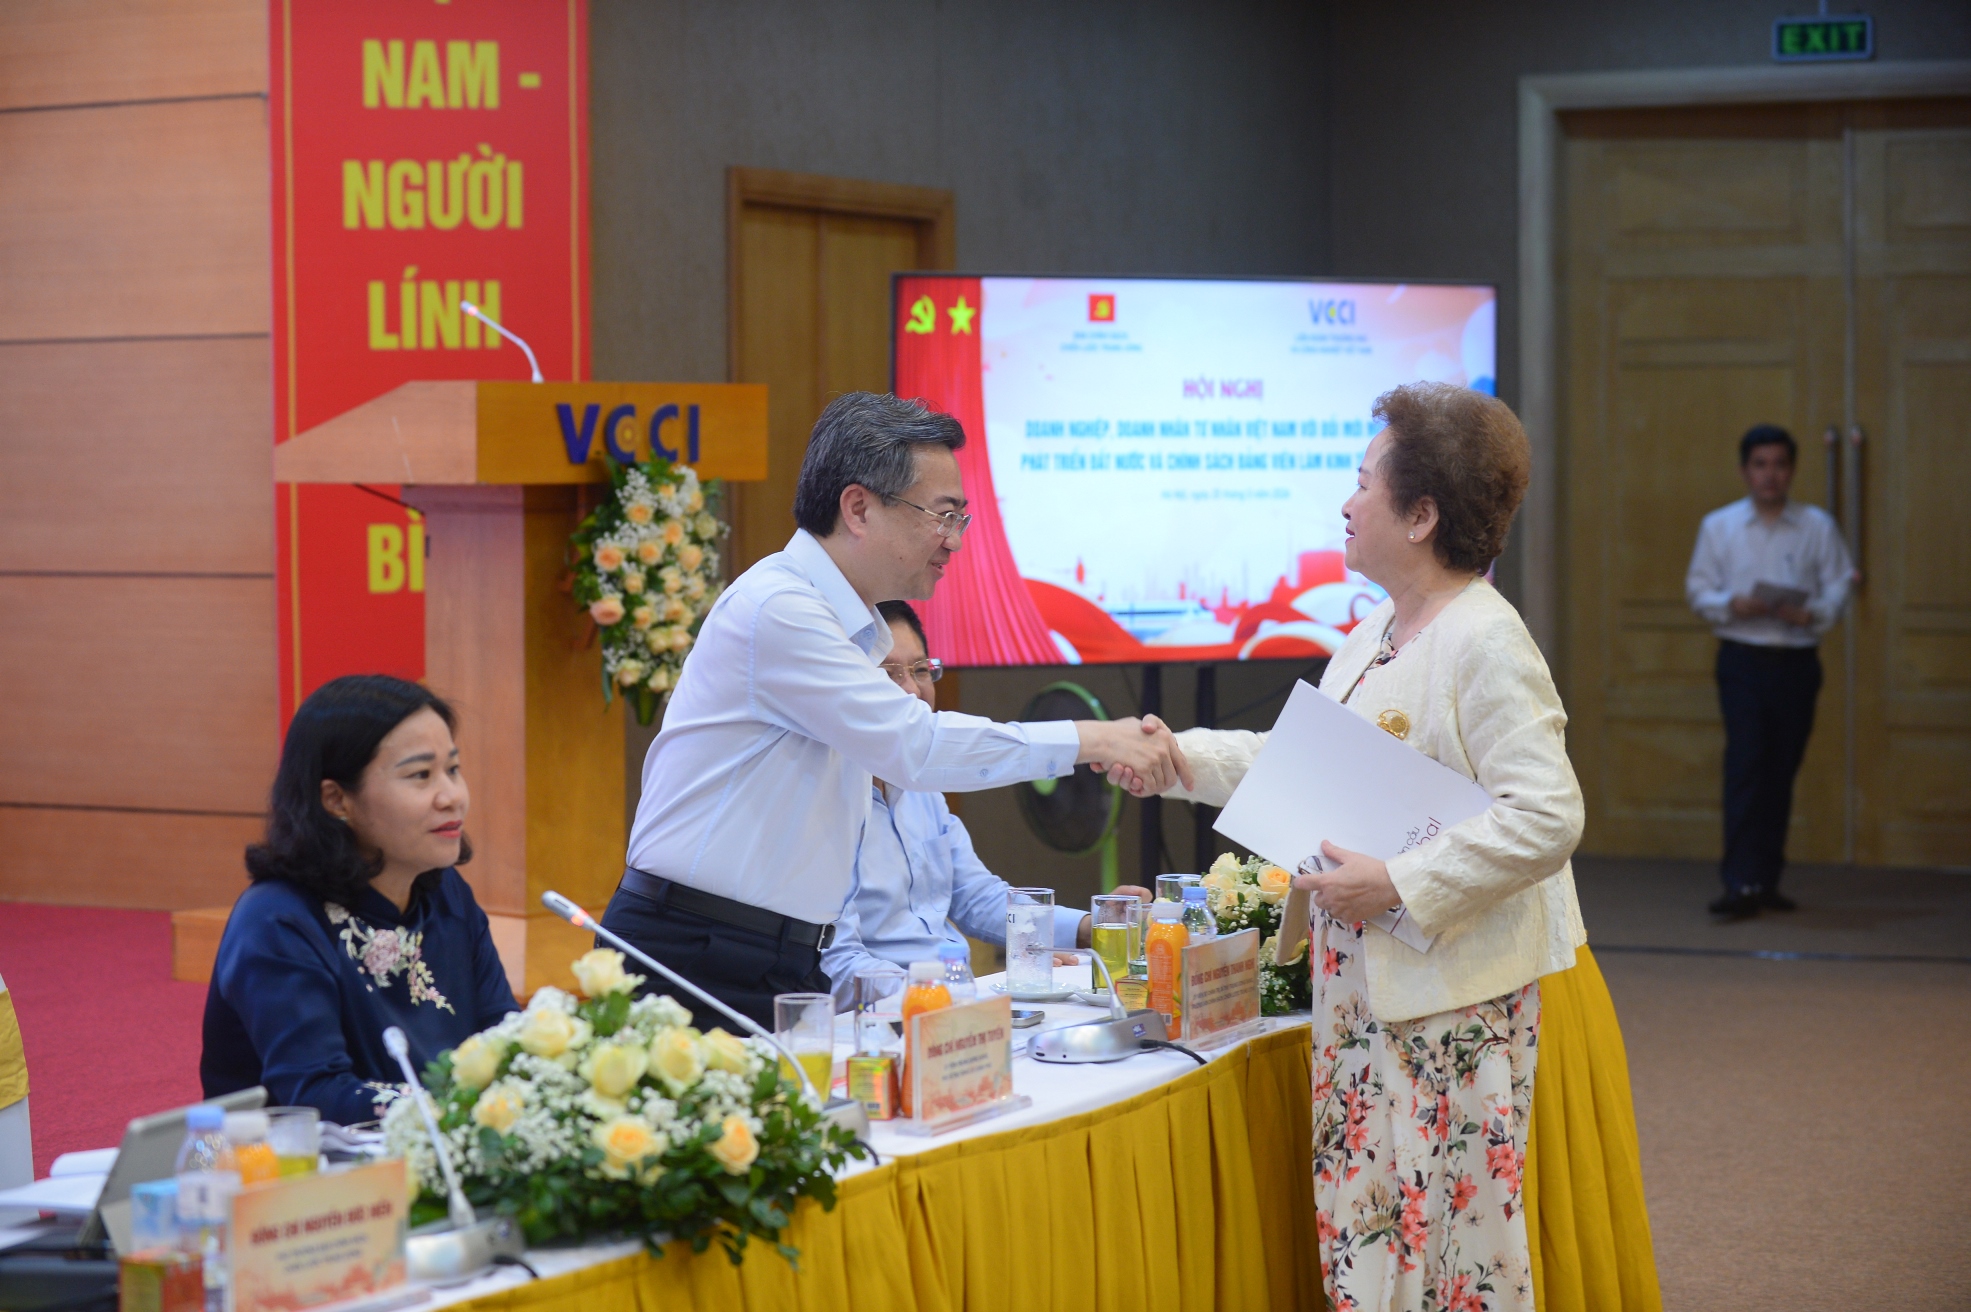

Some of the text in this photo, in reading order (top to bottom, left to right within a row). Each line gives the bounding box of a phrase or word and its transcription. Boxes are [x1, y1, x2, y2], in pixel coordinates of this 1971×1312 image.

[1781, 23, 1863, 54] EXIT
[362, 38, 542, 110] NAM -
[342, 142, 524, 231] NGƯỜI
[367, 264, 502, 351] LÍNH
[1307, 299, 1355, 325] VCCI
[1183, 374, 1215, 400] HỘI
[555, 402, 700, 465] VCCI
